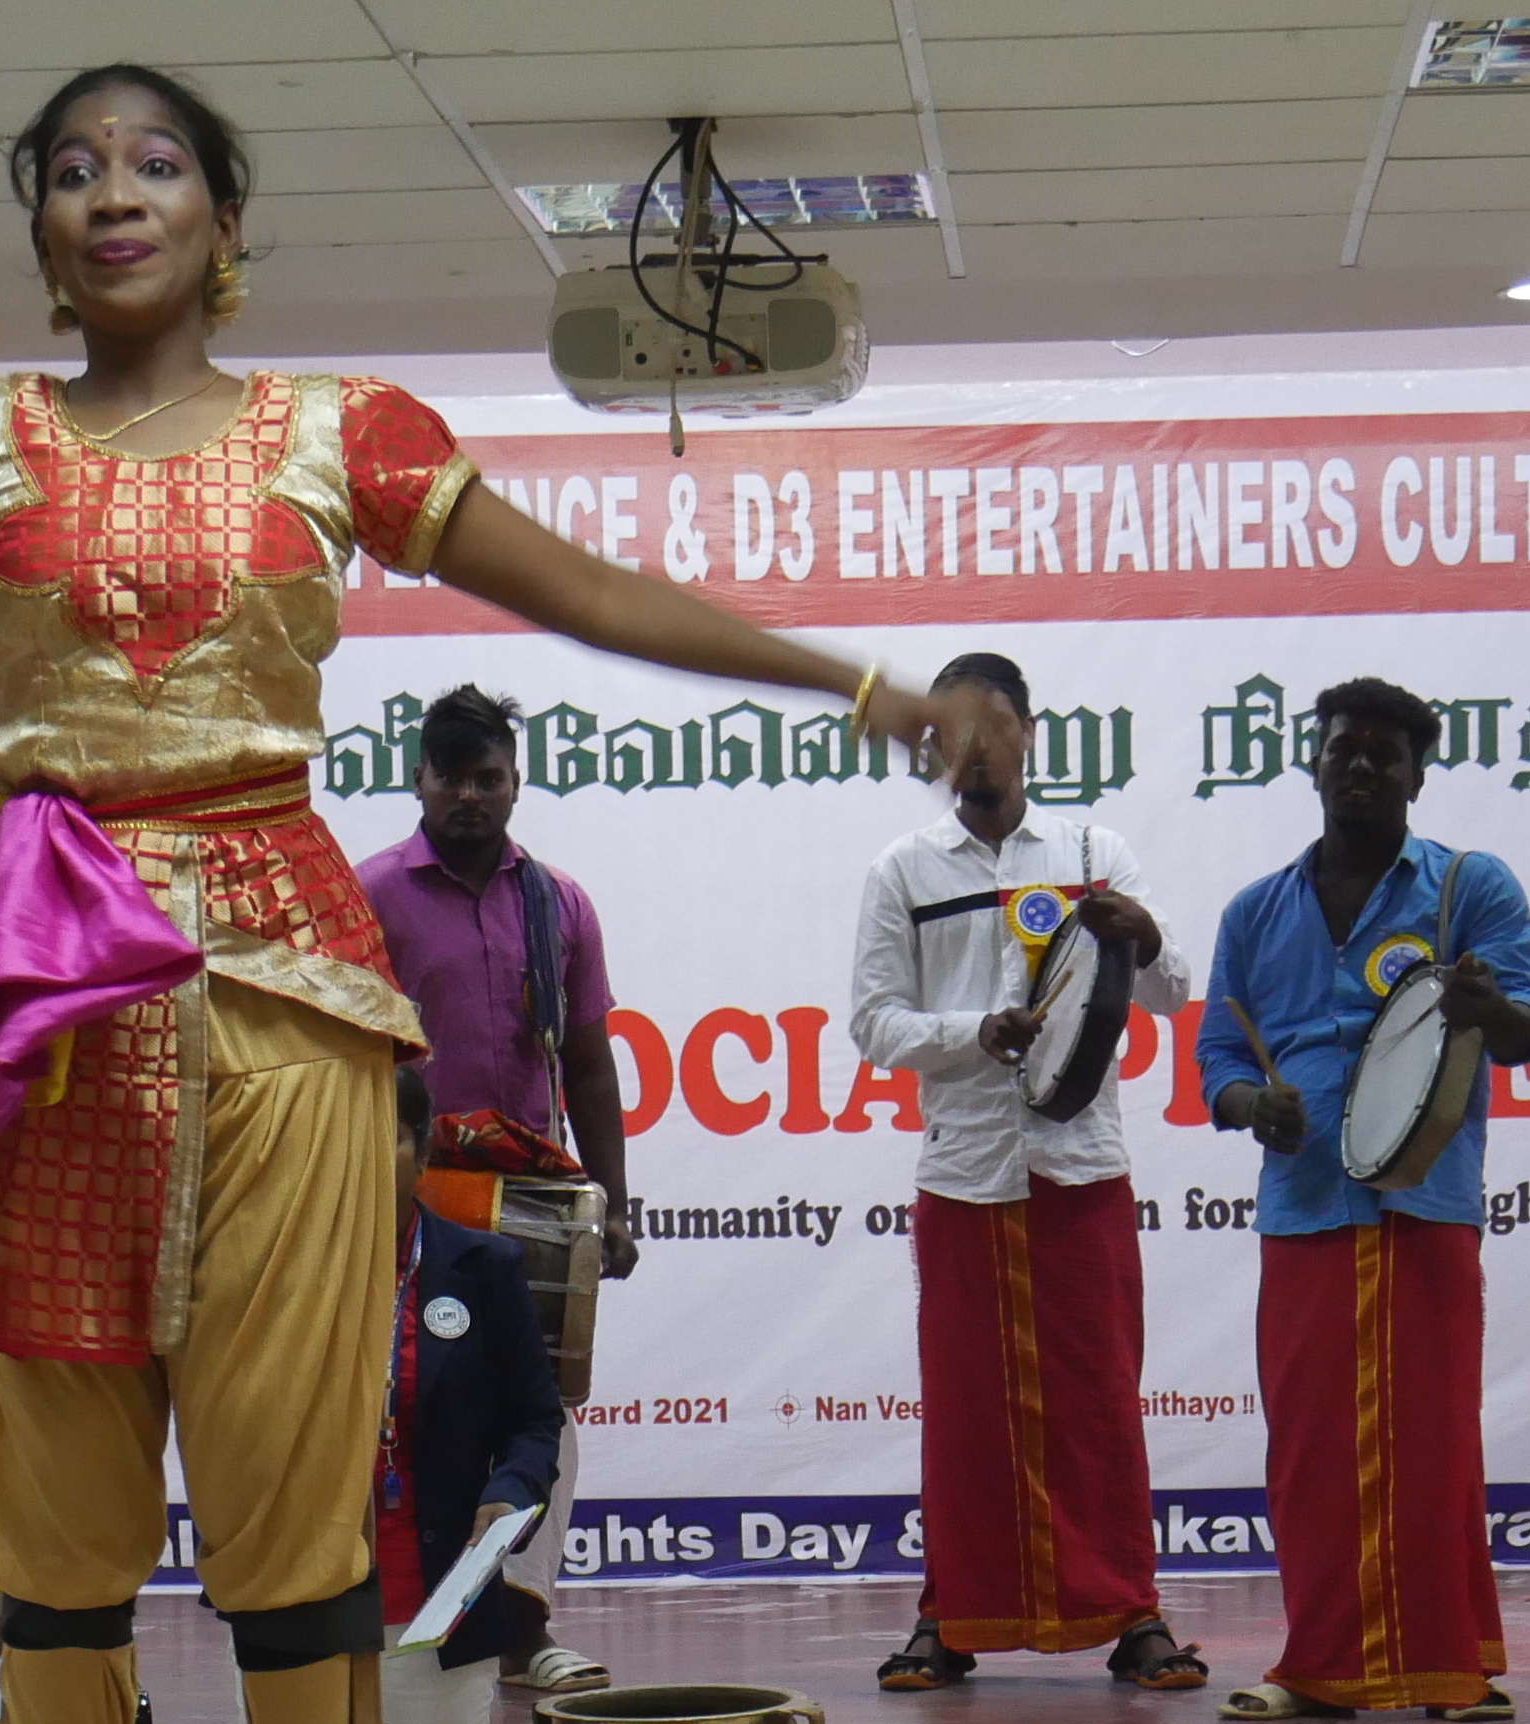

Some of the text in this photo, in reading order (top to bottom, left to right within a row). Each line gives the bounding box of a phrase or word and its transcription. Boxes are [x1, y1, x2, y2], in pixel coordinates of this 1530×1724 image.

[663, 472, 710, 583] &
[733, 470, 814, 582] D3
[838, 456, 1357, 579] ENTERTAINERS
[625, 1195, 843, 1248] Humanity
[1185, 1186, 1256, 1231] for
[653, 1397, 729, 1424] 2021
[815, 1396, 868, 1422] Nan
[740, 1511, 872, 1571] Day
